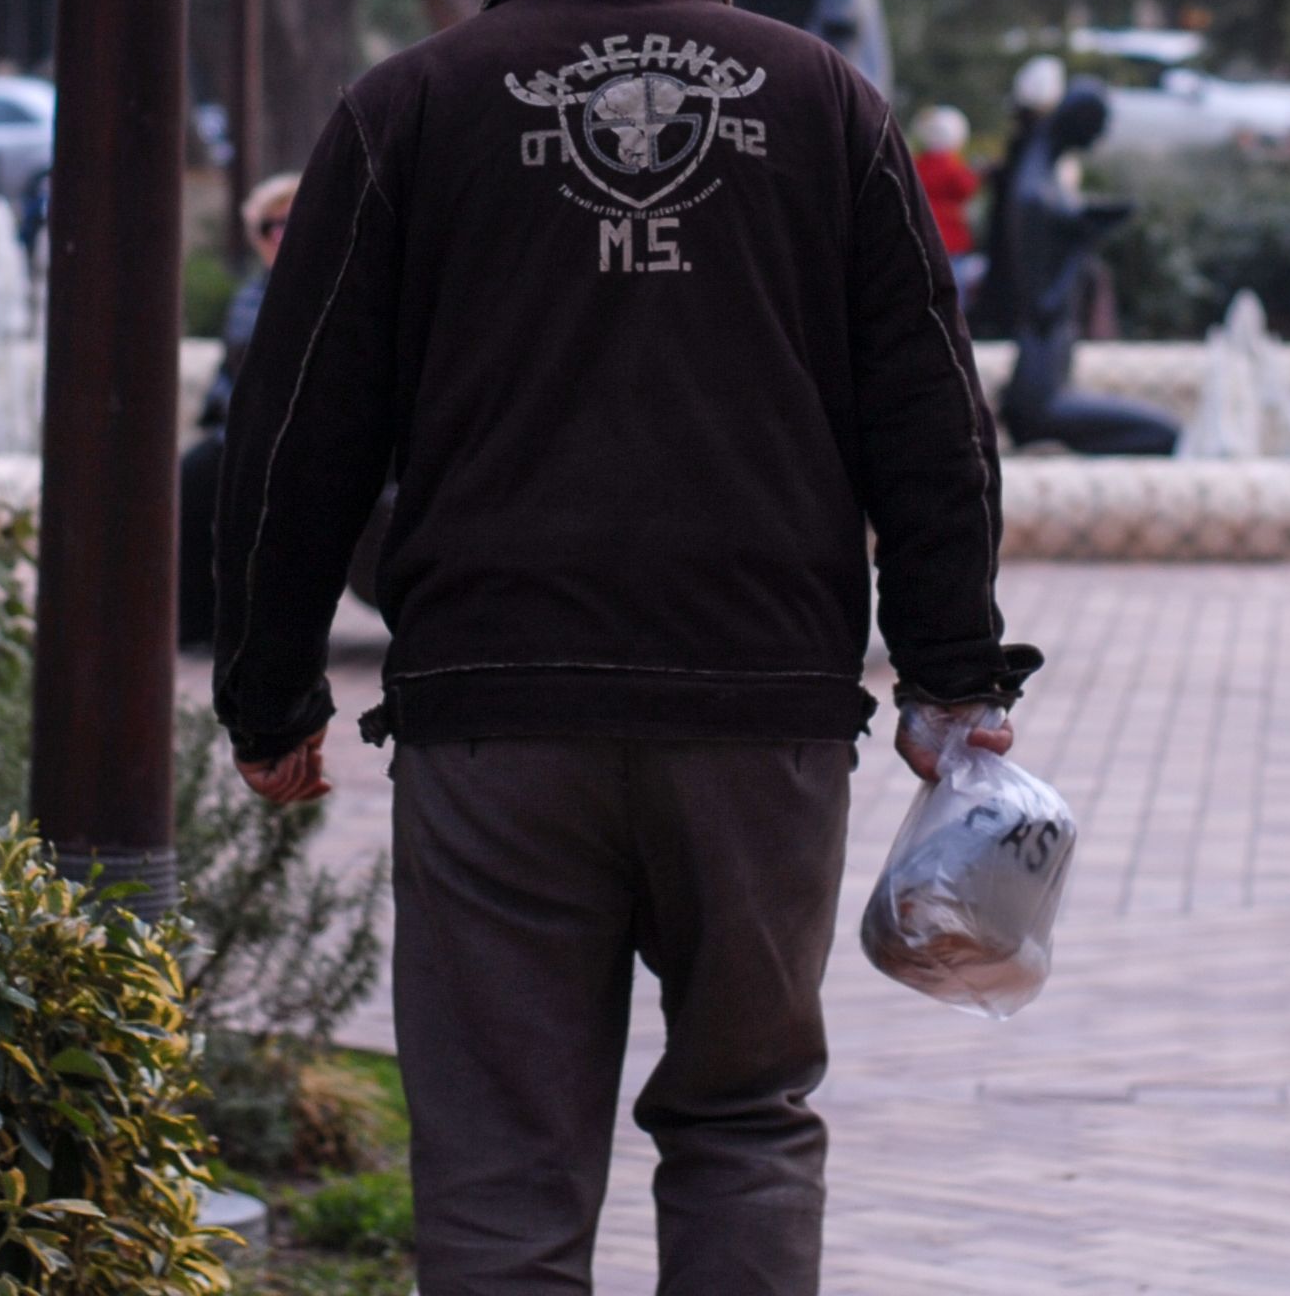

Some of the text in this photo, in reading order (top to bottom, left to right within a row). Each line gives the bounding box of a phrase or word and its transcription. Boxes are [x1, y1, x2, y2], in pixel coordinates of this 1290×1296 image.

[718, 115, 767, 157] 92
[604, 206, 622, 217] the
[625, 210, 646, 220] wild
[599, 218, 692, 272] M.S.
